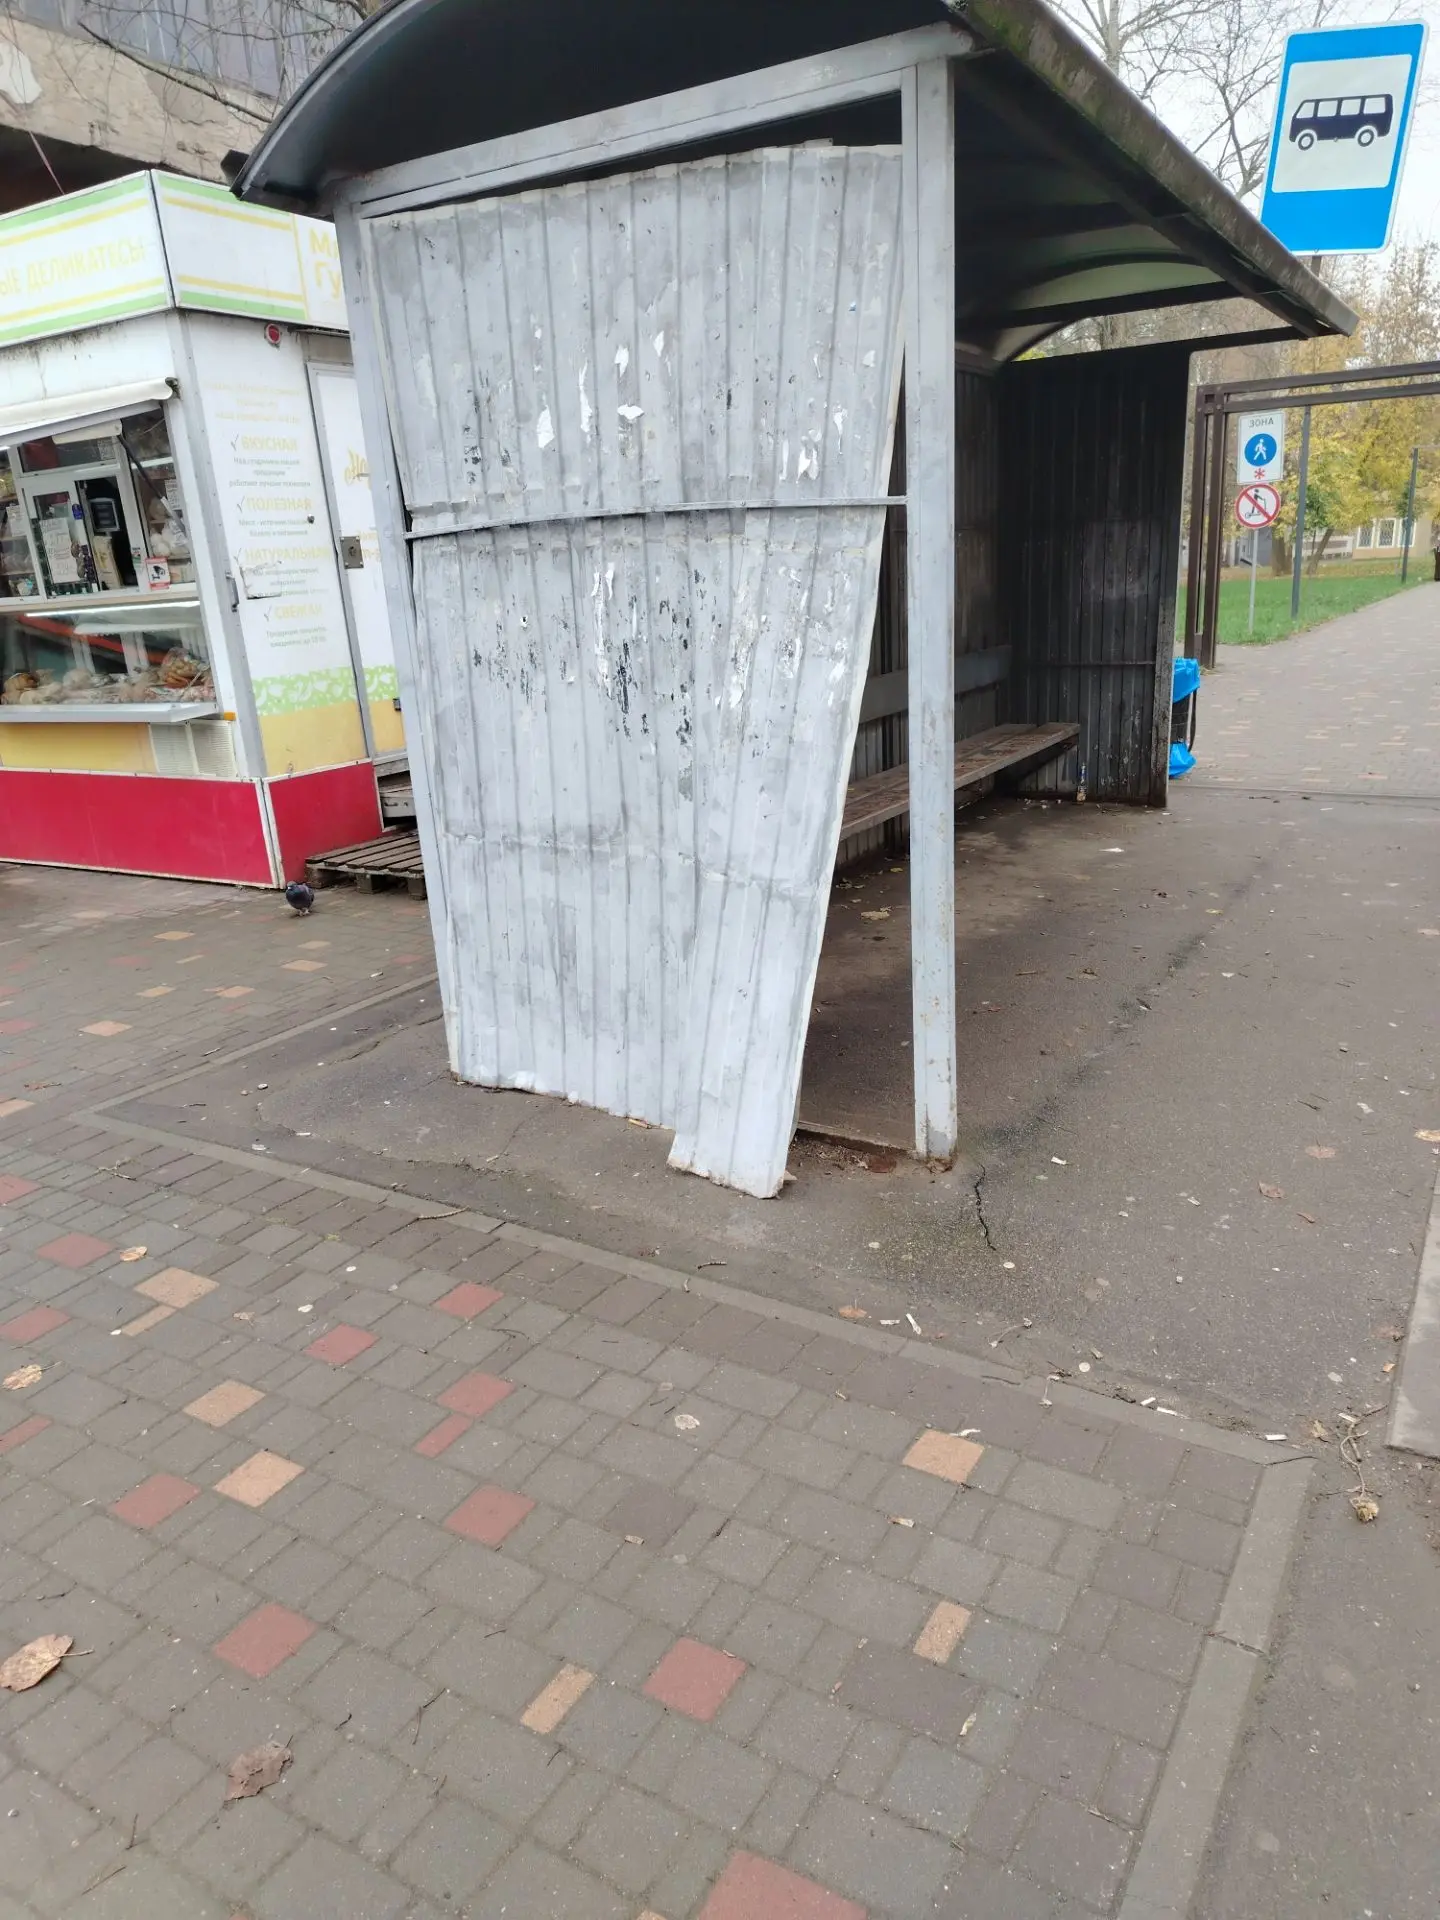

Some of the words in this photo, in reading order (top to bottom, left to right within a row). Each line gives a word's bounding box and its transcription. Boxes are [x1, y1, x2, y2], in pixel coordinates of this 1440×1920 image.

[27, 234, 147, 291] ДЕЛИКАТЕСЫ
[1248, 417, 1274, 429] ЗОНА
[241, 436, 298, 452] ВКУСНАЯ
[246, 497, 312, 512] ПОЛЕЗНАЯ
